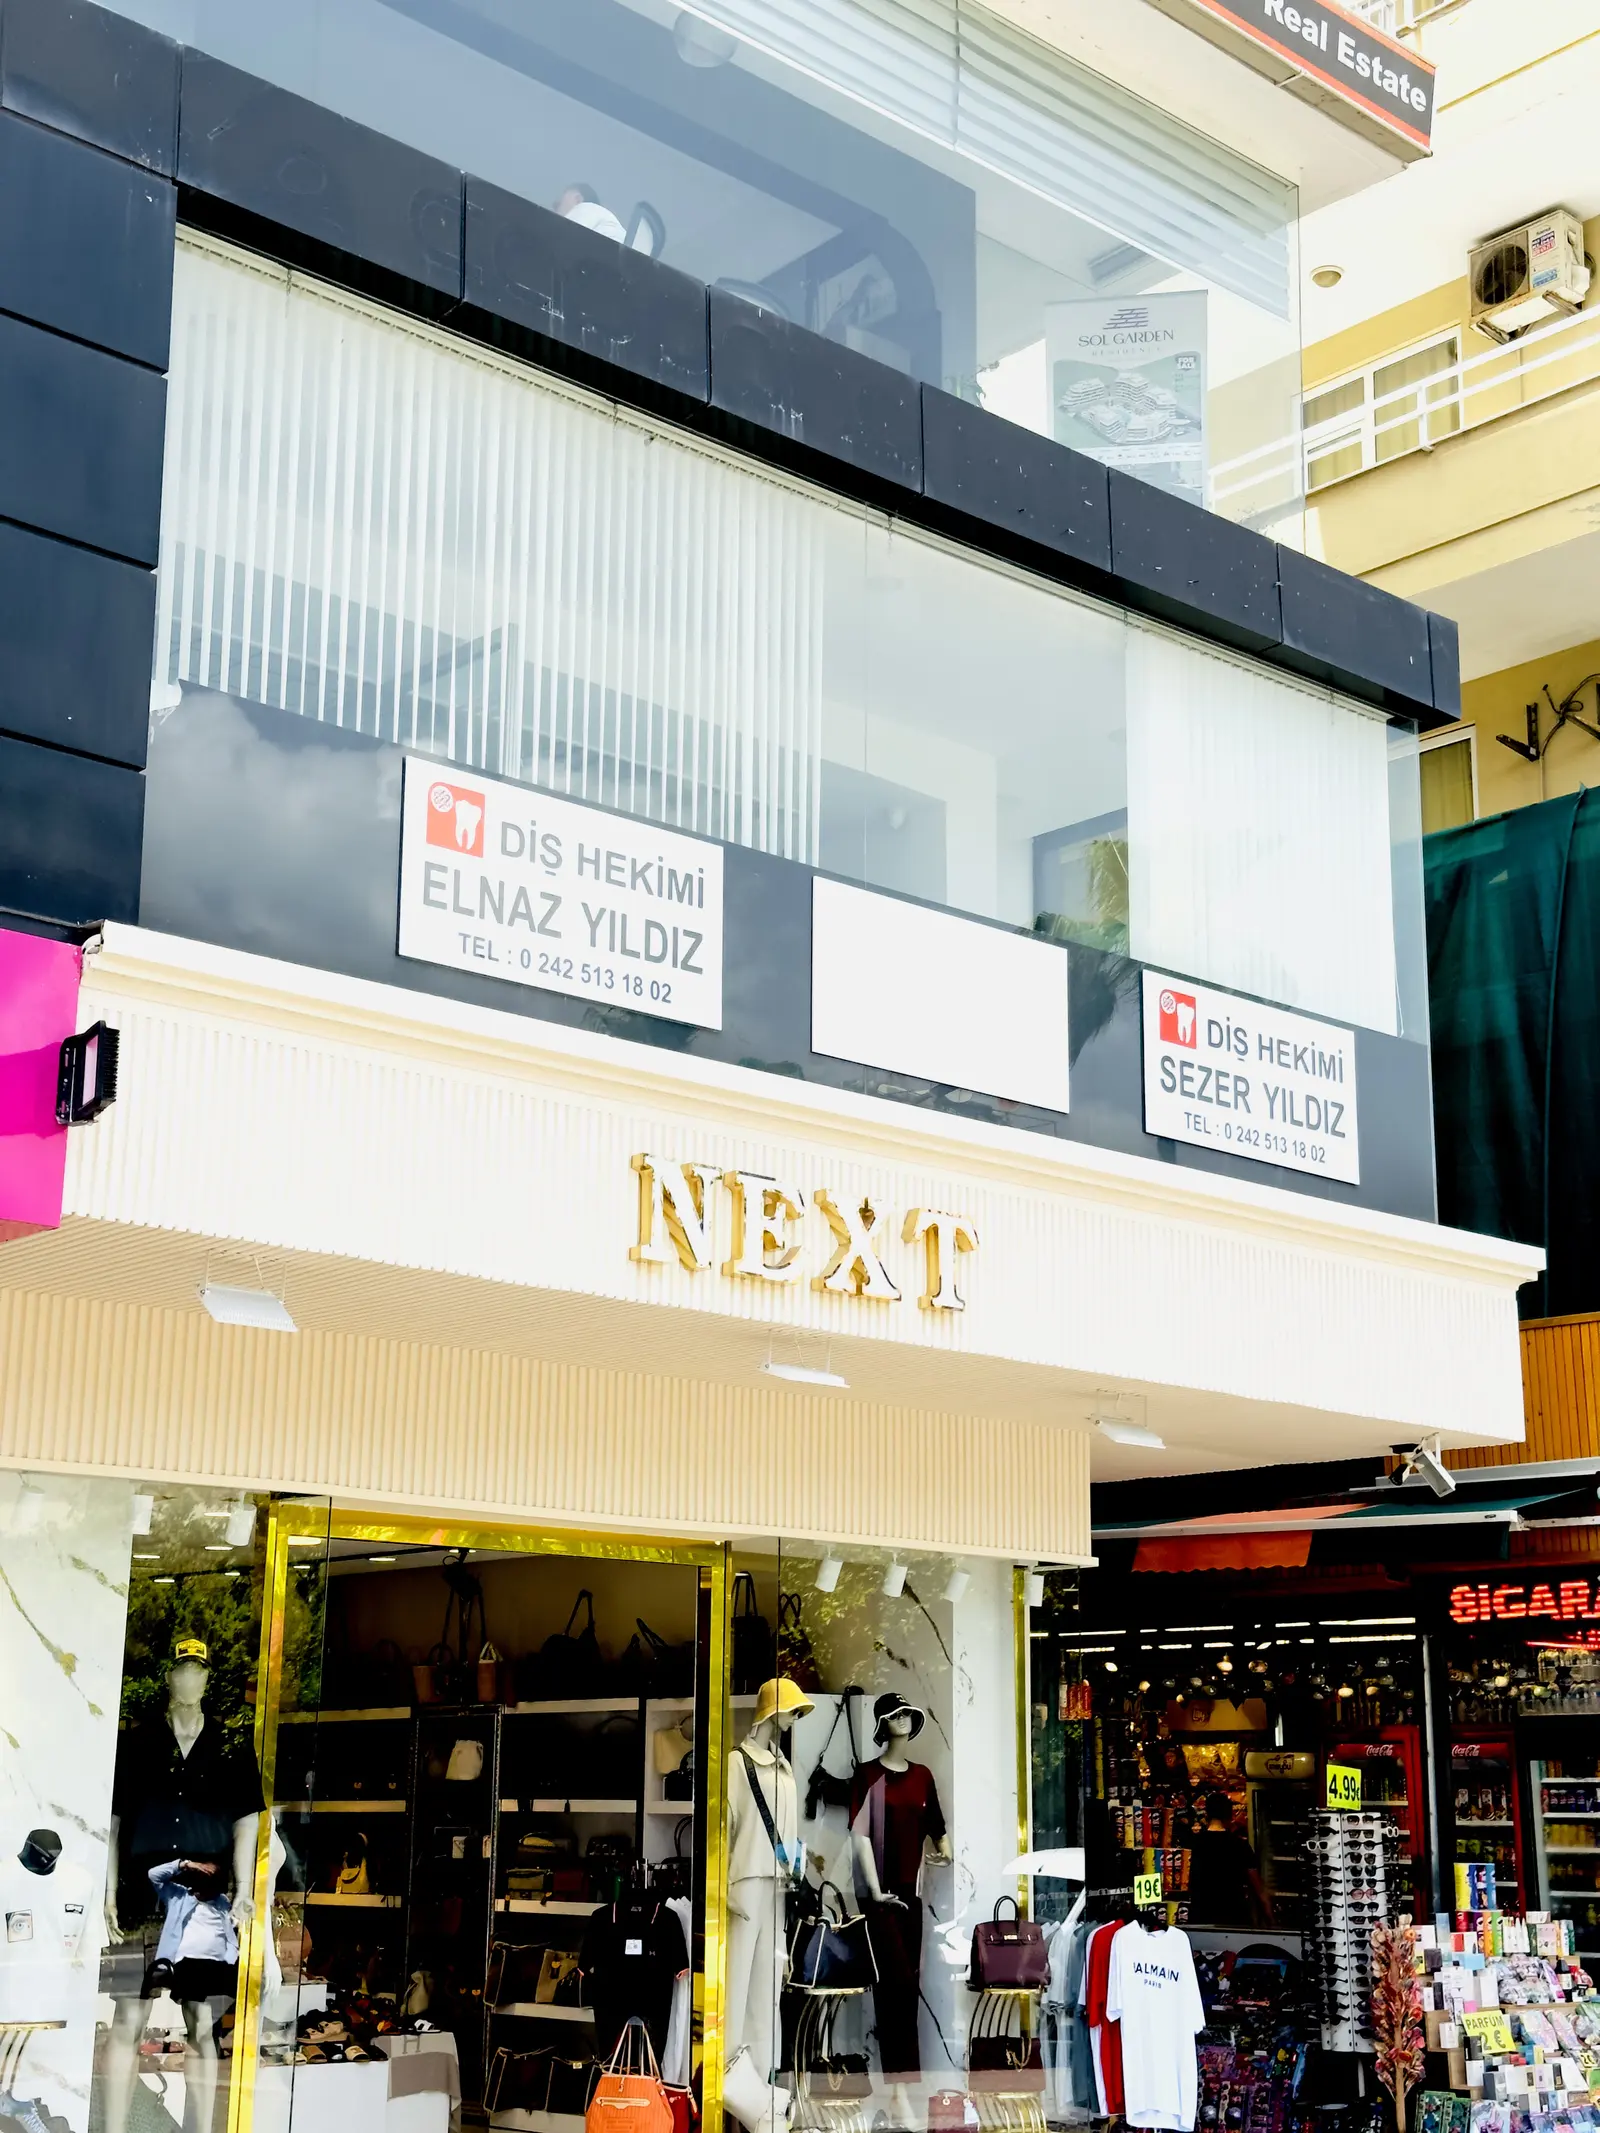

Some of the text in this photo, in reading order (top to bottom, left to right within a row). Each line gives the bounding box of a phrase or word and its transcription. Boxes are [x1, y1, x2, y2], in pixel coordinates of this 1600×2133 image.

[1264, 0, 1427, 112] Real Estate
[1078, 329, 1175, 347] SOL GARDEN
[500, 820, 704, 909] DİŞ HEKİMİ
[422, 860, 703, 975] ELNAZ YILDIZ
[458, 932, 499, 962] TEL
[519, 948, 532, 969] 0
[538, 952, 574, 980] 242
[581, 963, 616, 990] 513
[622, 973, 644, 997] 18
[649, 980, 672, 1004] 02
[1207, 1016, 1344, 1084] DİŞ HEKİMİ
[1160, 1055, 1346, 1139] SEZER YILDIZ
[1184, 1112, 1212, 1135] TEL
[1224, 1122, 1232, 1140] 0
[1236, 1126, 1260, 1147] 242
[1264, 1133, 1287, 1154] 513
[1292, 1141, 1307, 1159] 18
[1310, 1146, 1326, 1164] 02
[628, 1152, 981, 1312] NEXT
[1329, 1773, 1360, 1801] 4.99€
[1135, 1878, 1160, 1900] 19€
[1479, 2029, 1507, 2051] 2 €
